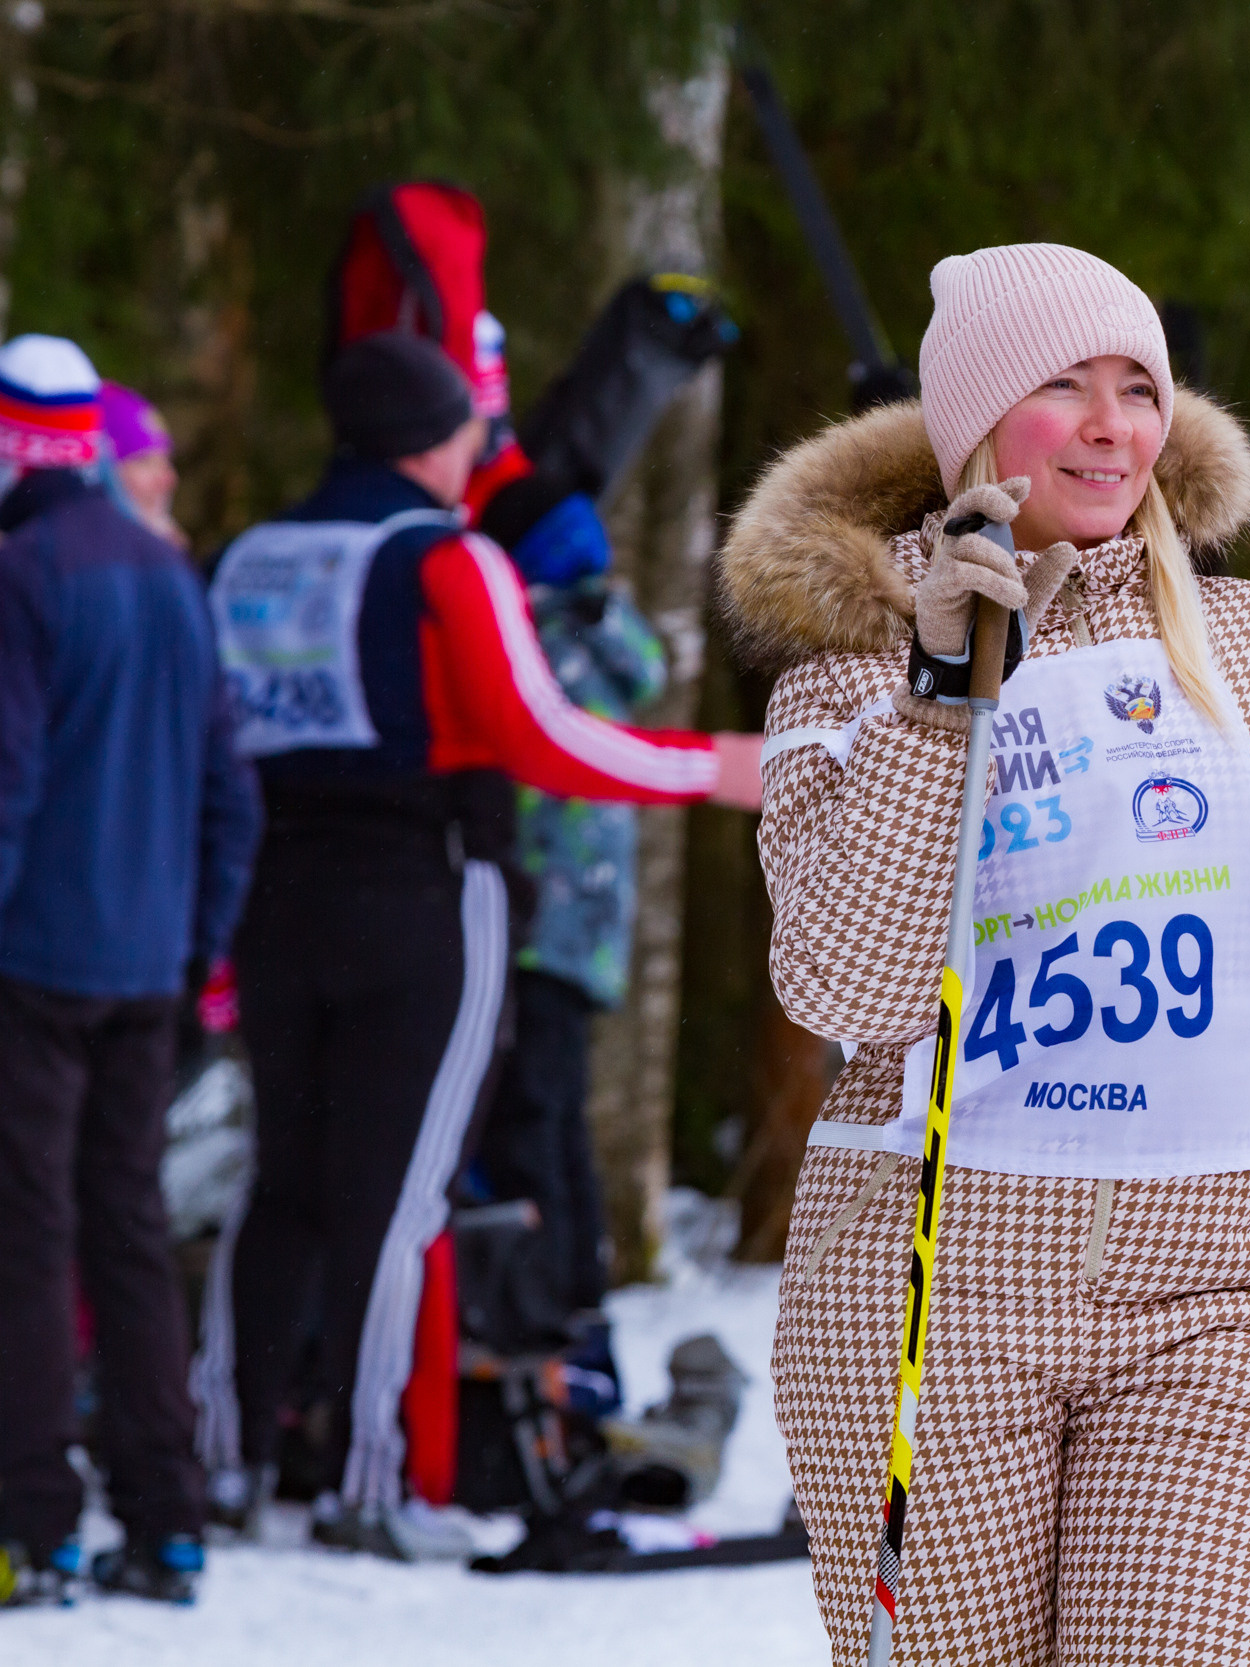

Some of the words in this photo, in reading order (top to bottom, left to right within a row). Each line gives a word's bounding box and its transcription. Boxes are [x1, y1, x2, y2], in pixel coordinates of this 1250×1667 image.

[1106, 742, 1163, 754] МИНИСТЕРСТВО
[1164, 739, 1194, 748] СПОРТА
[1106, 750, 1155, 762] РОССИЙСКОЙ
[1156, 747, 1202, 758] ФЕДЕРАЦИИ
[1134, 865, 1231, 898] ЖИЗНИ
[963, 913, 1214, 1072] 4539
[1024, 1081, 1148, 1112] МОСКВА
